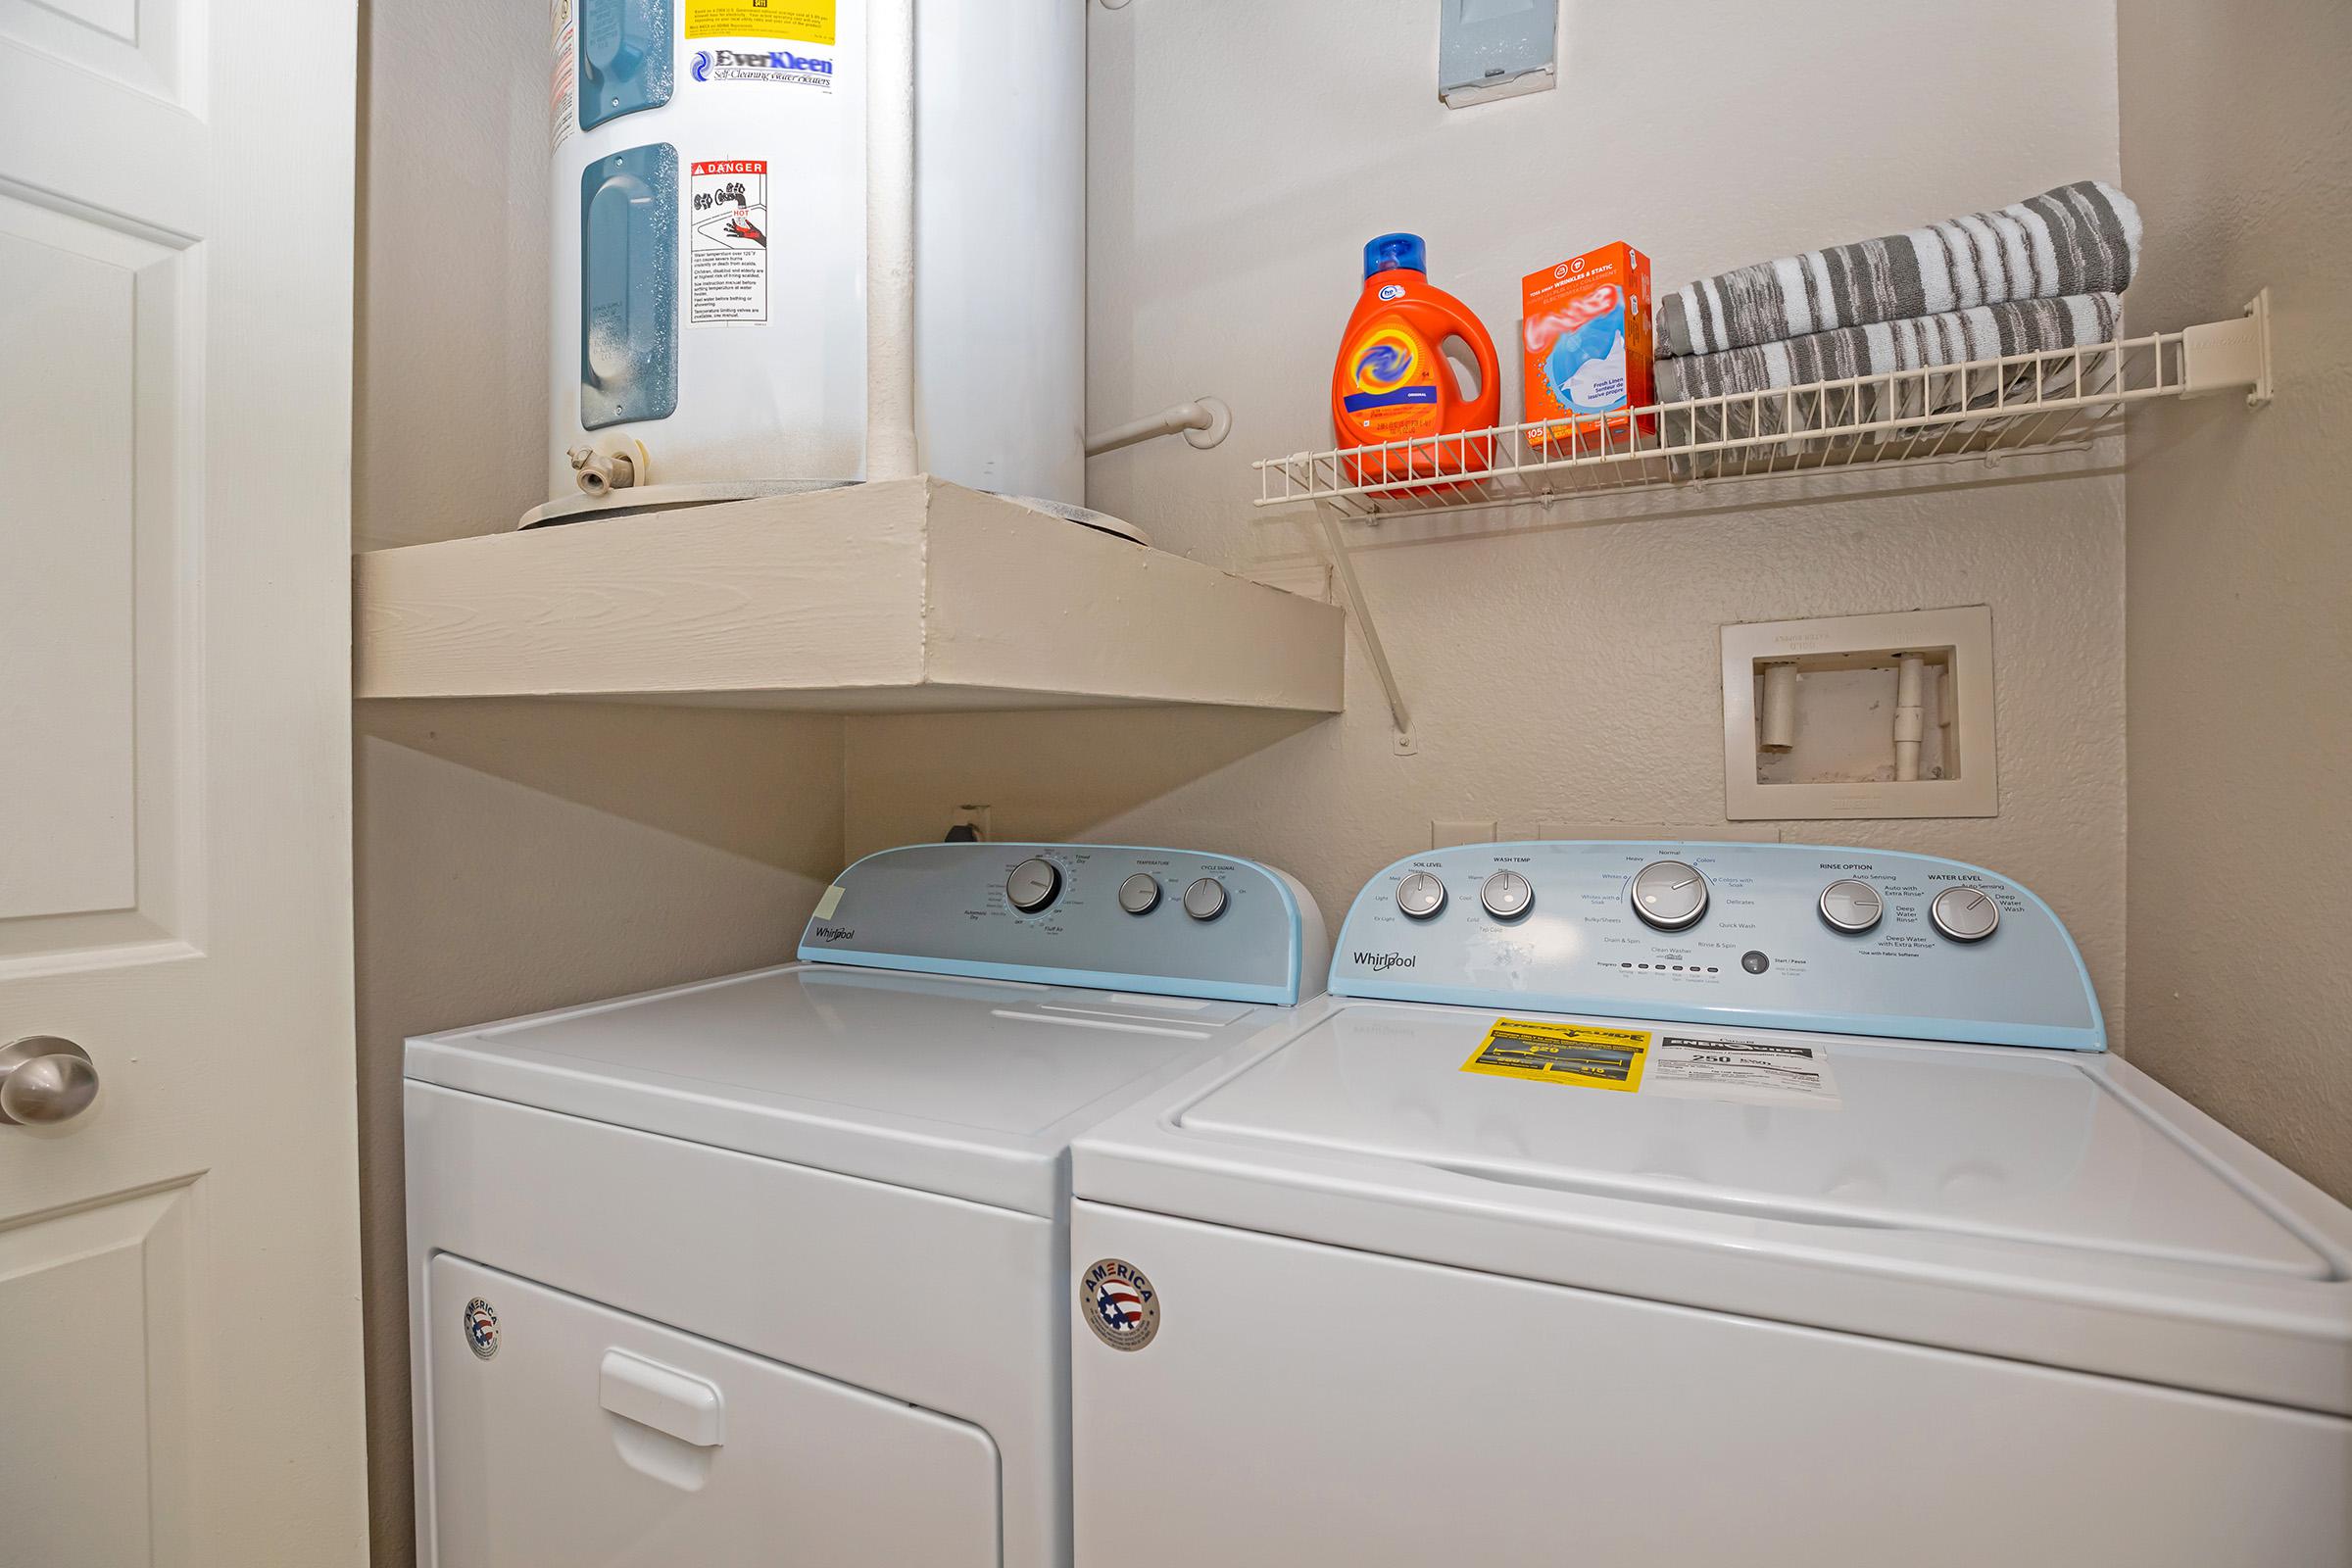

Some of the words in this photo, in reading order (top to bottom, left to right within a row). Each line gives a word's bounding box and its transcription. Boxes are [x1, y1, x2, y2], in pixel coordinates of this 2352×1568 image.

[713, 70, 770, 81] Self-Cleaning
[708, 163, 762, 173] DANGER
[1554, 273, 1586, 288] WRINKLES
[1591, 264, 1613, 275] STATIC
[1528, 427, 1544, 439] 105
[816, 927, 856, 942] Whirlpool
[1353, 952, 1416, 971] Whirlpool
[1085, 1262, 1152, 1302] AMERICA
[466, 1299, 497, 1325] AMERICA
